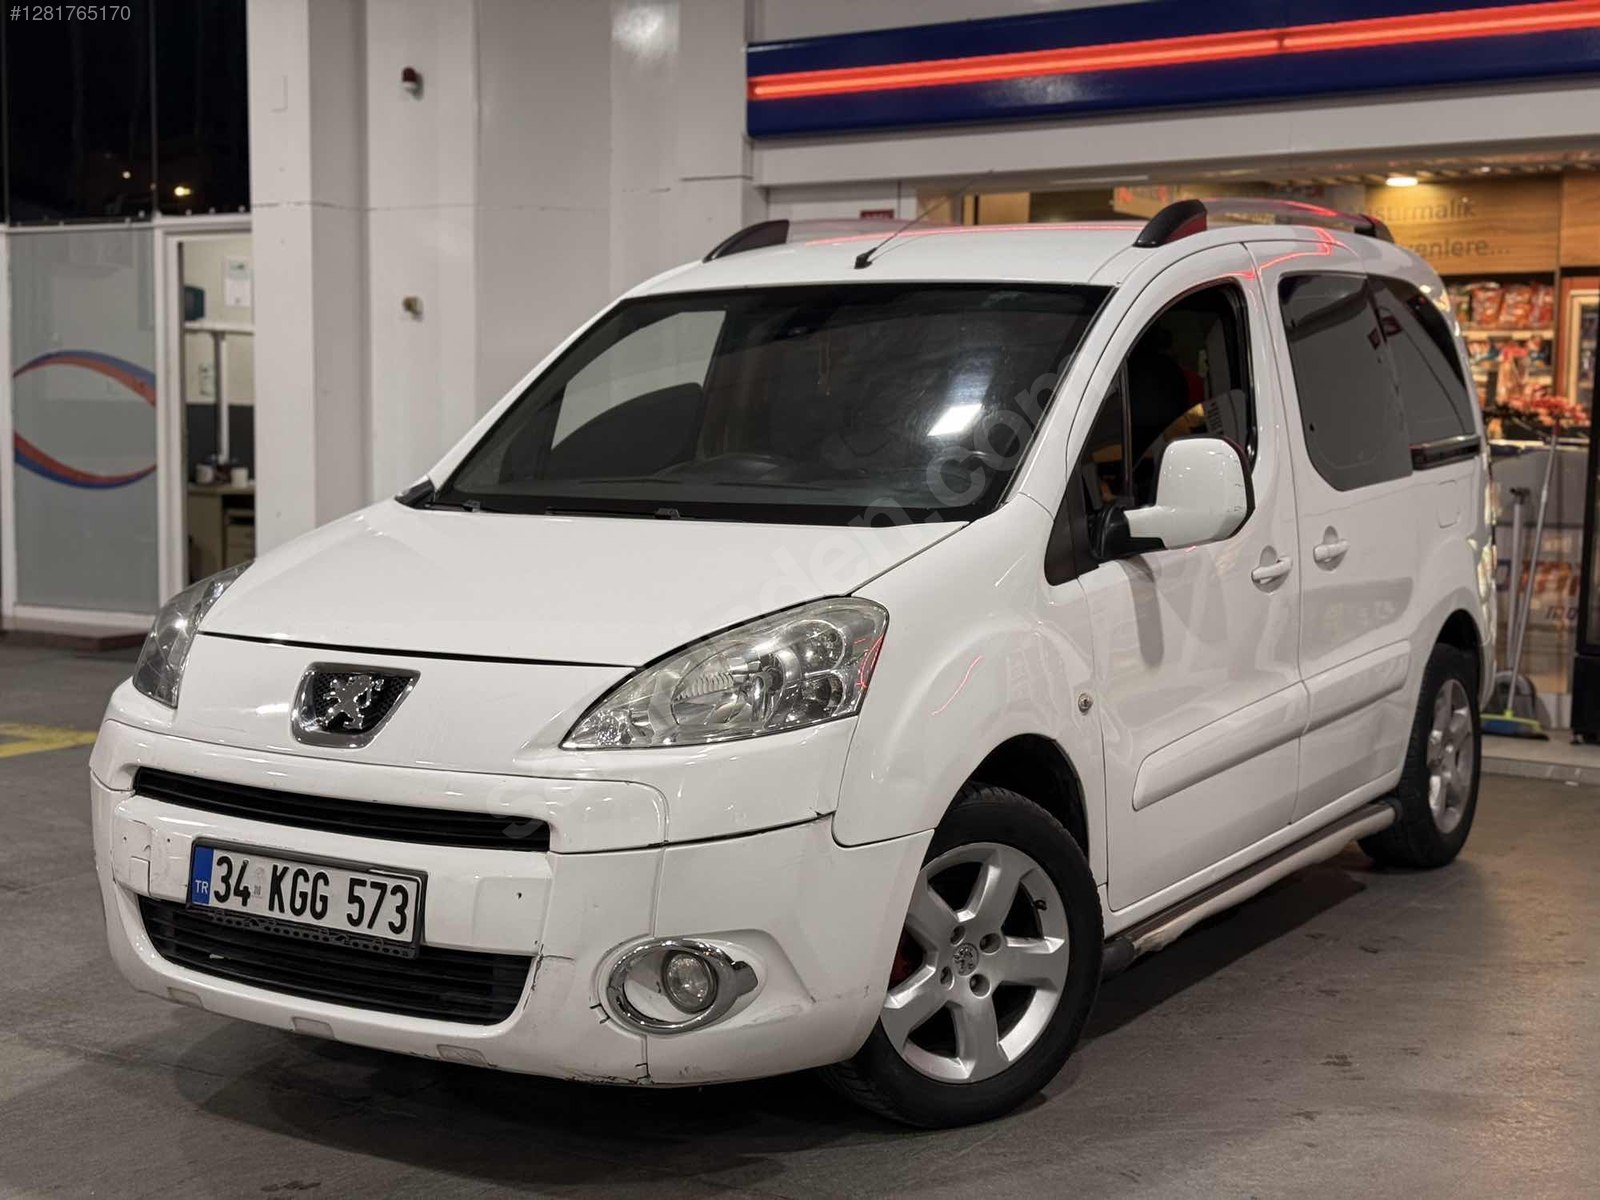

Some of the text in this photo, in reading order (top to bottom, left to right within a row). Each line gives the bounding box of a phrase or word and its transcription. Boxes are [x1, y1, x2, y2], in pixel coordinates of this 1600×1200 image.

[195, 879, 209, 894] TR
[213, 855, 409, 934] 34 KGG 573
